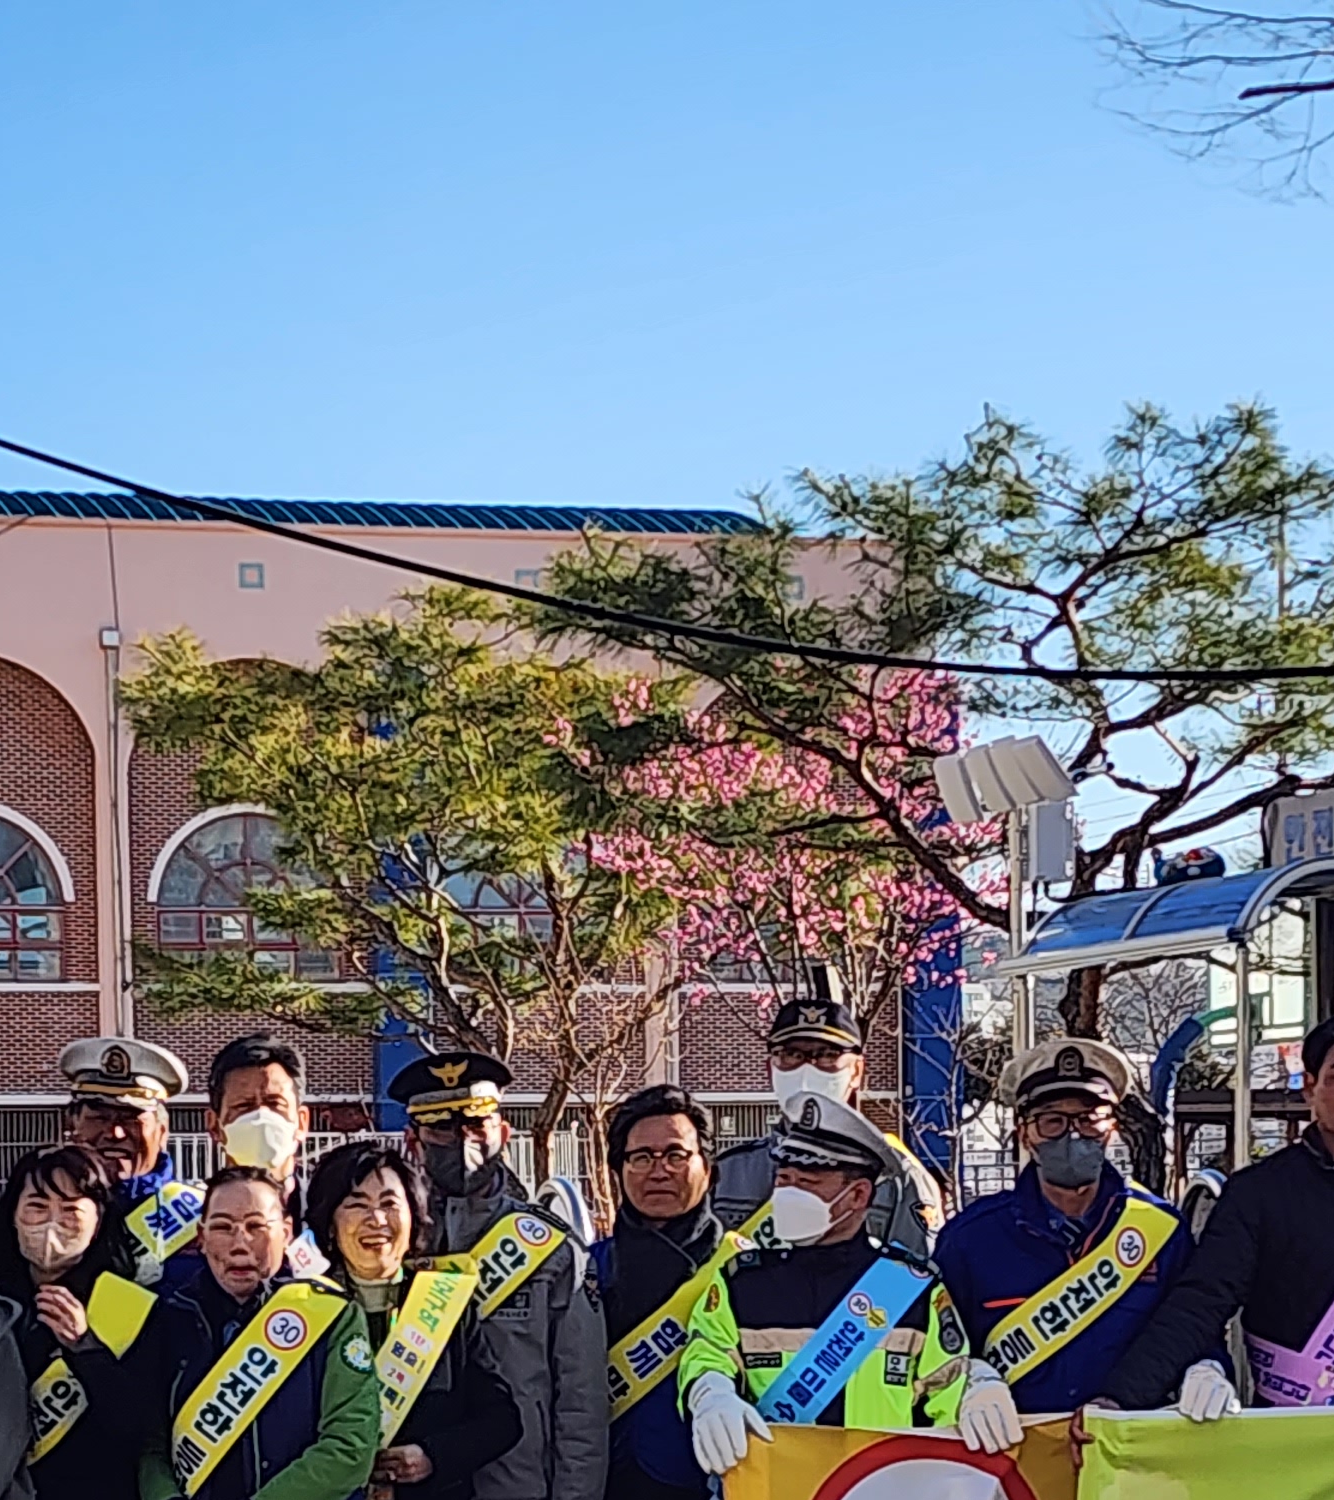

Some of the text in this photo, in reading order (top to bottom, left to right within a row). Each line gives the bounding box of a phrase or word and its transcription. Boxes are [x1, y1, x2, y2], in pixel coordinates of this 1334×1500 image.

[521, 1220, 546, 1241] 30
[852, 1296, 869, 1312] 30
[1031, 1258, 1122, 1342] 안전한
[272, 1317, 301, 1344] 30
[625, 1316, 689, 1380] 함께
[193, 1346, 279, 1443] 안전한
